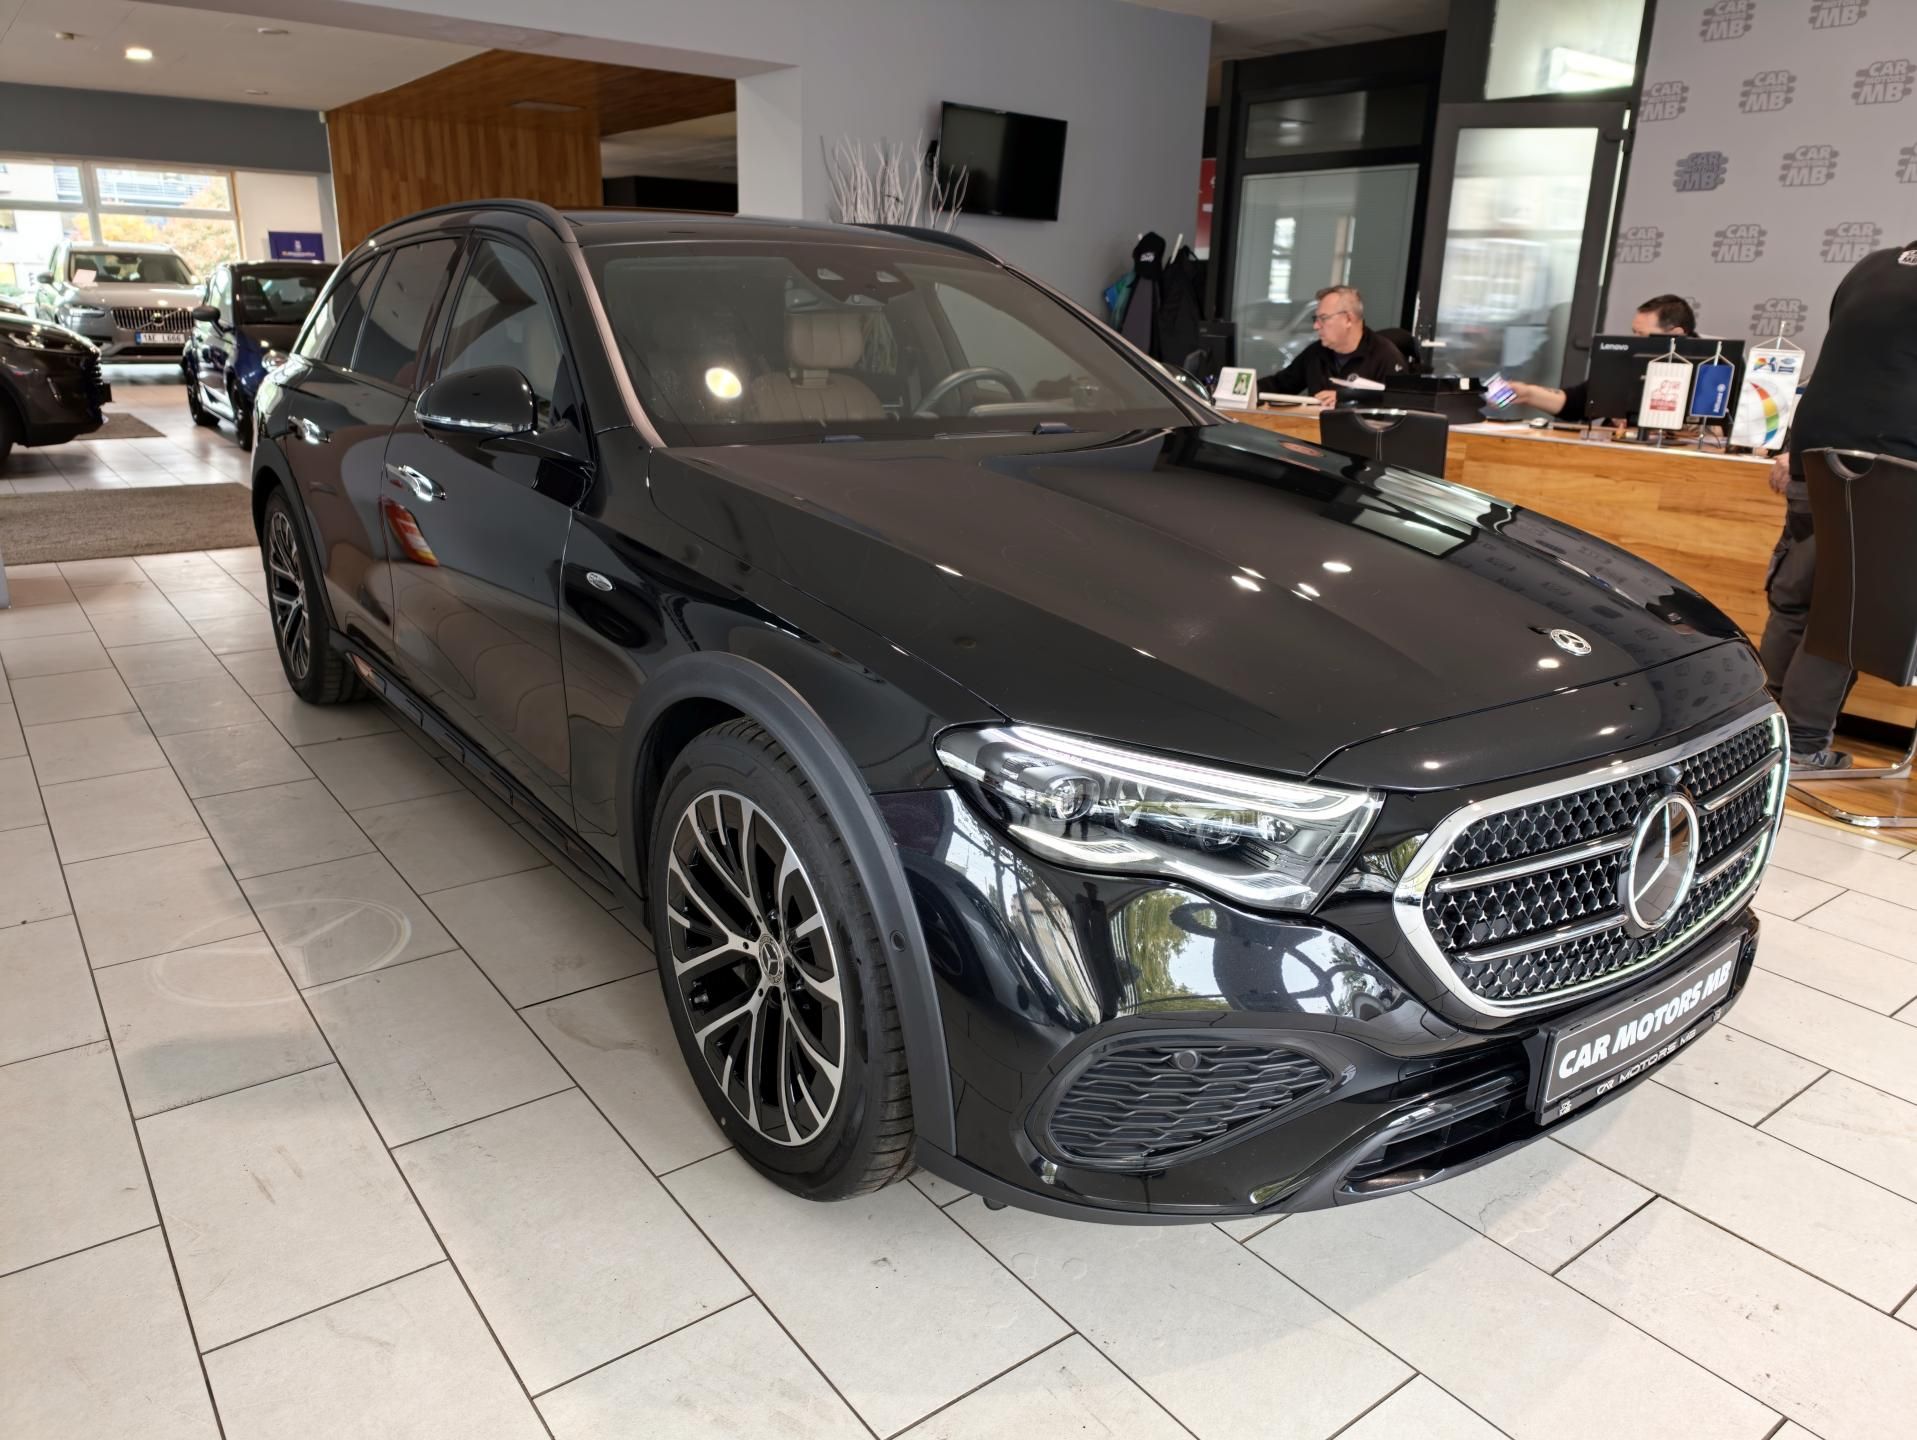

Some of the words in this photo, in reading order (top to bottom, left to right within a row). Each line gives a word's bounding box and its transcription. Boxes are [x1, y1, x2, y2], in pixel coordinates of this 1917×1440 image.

[1714, 0, 1748, 15] CAR
[1812, 6, 1860, 29] MB
[1702, 19, 1746, 42] MB
[1868, 59, 1910, 76] CAR
[1753, 70, 1790, 86] CAR
[1651, 81, 1684, 96] CAR
[1855, 83, 1905, 105] MB
[1741, 91, 1787, 113] MB
[1640, 101, 1680, 122] MB
[1795, 145, 1833, 160] CAR
[1676, 172, 1720, 191] MB
[1781, 166, 1829, 187] MB
[1626, 227, 1659, 240] CAR
[1725, 224, 1761, 238] CAR
[1837, 222, 1877, 237] CAR
[1616, 245, 1655, 263] MB
[1714, 244, 1758, 263] MB
[1823, 243, 1871, 263] MB
[1764, 298, 1802, 313] CAR
[1753, 318, 1797, 336] MB
[1600, 342, 1629, 351] Lenovo
[1558, 1034, 1611, 1079] CAR
[1612, 980, 1703, 1055] MOTORS
[1701, 960, 1732, 1001] MB
[1596, 1078, 1615, 1095] CAR
[1619, 1041, 1678, 1084] MOTORS
